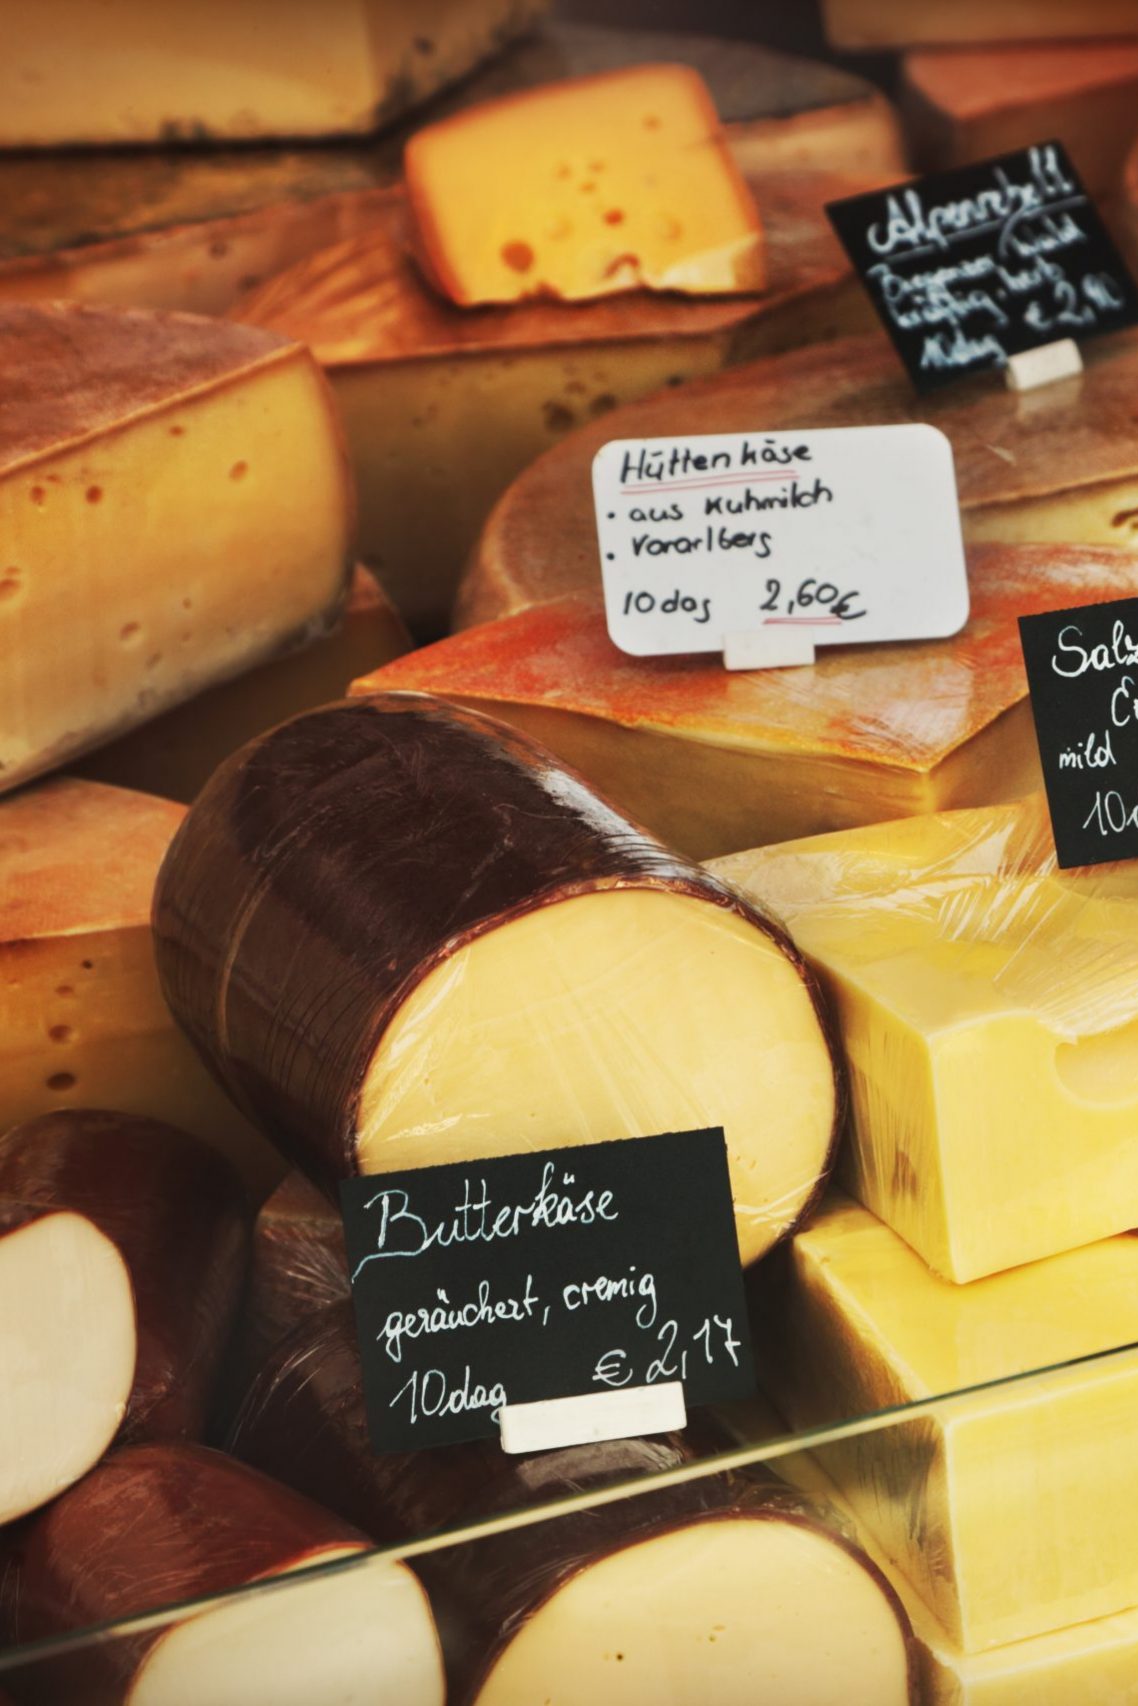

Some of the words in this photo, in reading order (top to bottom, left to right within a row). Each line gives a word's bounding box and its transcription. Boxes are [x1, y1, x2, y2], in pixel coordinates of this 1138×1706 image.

[629, 502, 684, 523] aus
[1058, 729, 1118, 770] mild
[351, 1161, 619, 1284] Butterkäse
[376, 1274, 551, 1363] geräuchert,
[563, 1266, 657, 1329] cremig
[591, 1349, 634, 1387] €
[645, 1313, 742, 1384] 2,17
